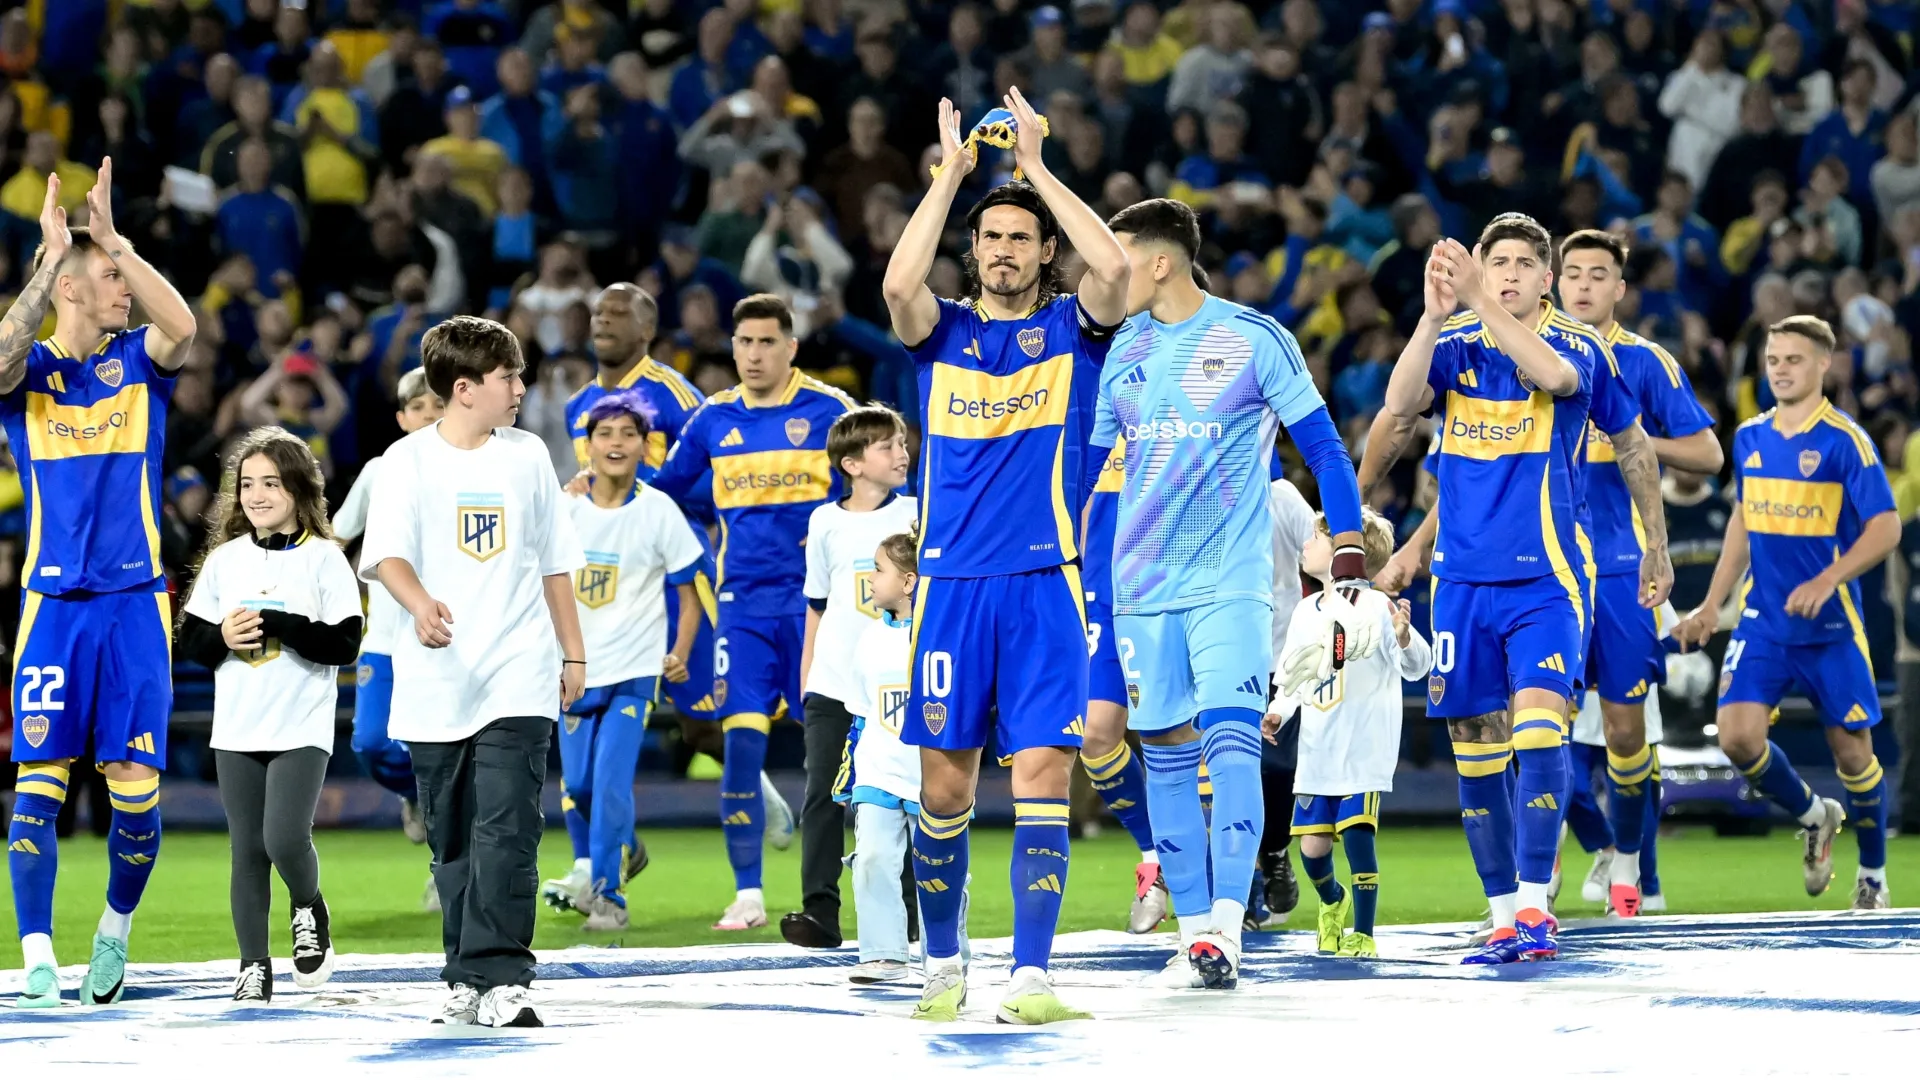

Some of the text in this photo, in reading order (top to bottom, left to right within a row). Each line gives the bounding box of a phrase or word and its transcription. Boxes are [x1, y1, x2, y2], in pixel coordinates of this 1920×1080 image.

[948, 389, 1050, 419] betsson
[1123, 417, 1223, 442] betsson
[1451, 416, 1535, 441] betsson
[722, 469, 812, 492] betsson
[464, 513, 499, 553] LPF
[580, 568, 612, 602] LPF
[1335, 633, 1345, 661] adidas
[1721, 638, 1747, 674] 21
[21, 665, 65, 711] 22
[922, 650, 953, 698] 10
[12, 813, 45, 826] CABJ
[913, 846, 955, 866] CABJ
